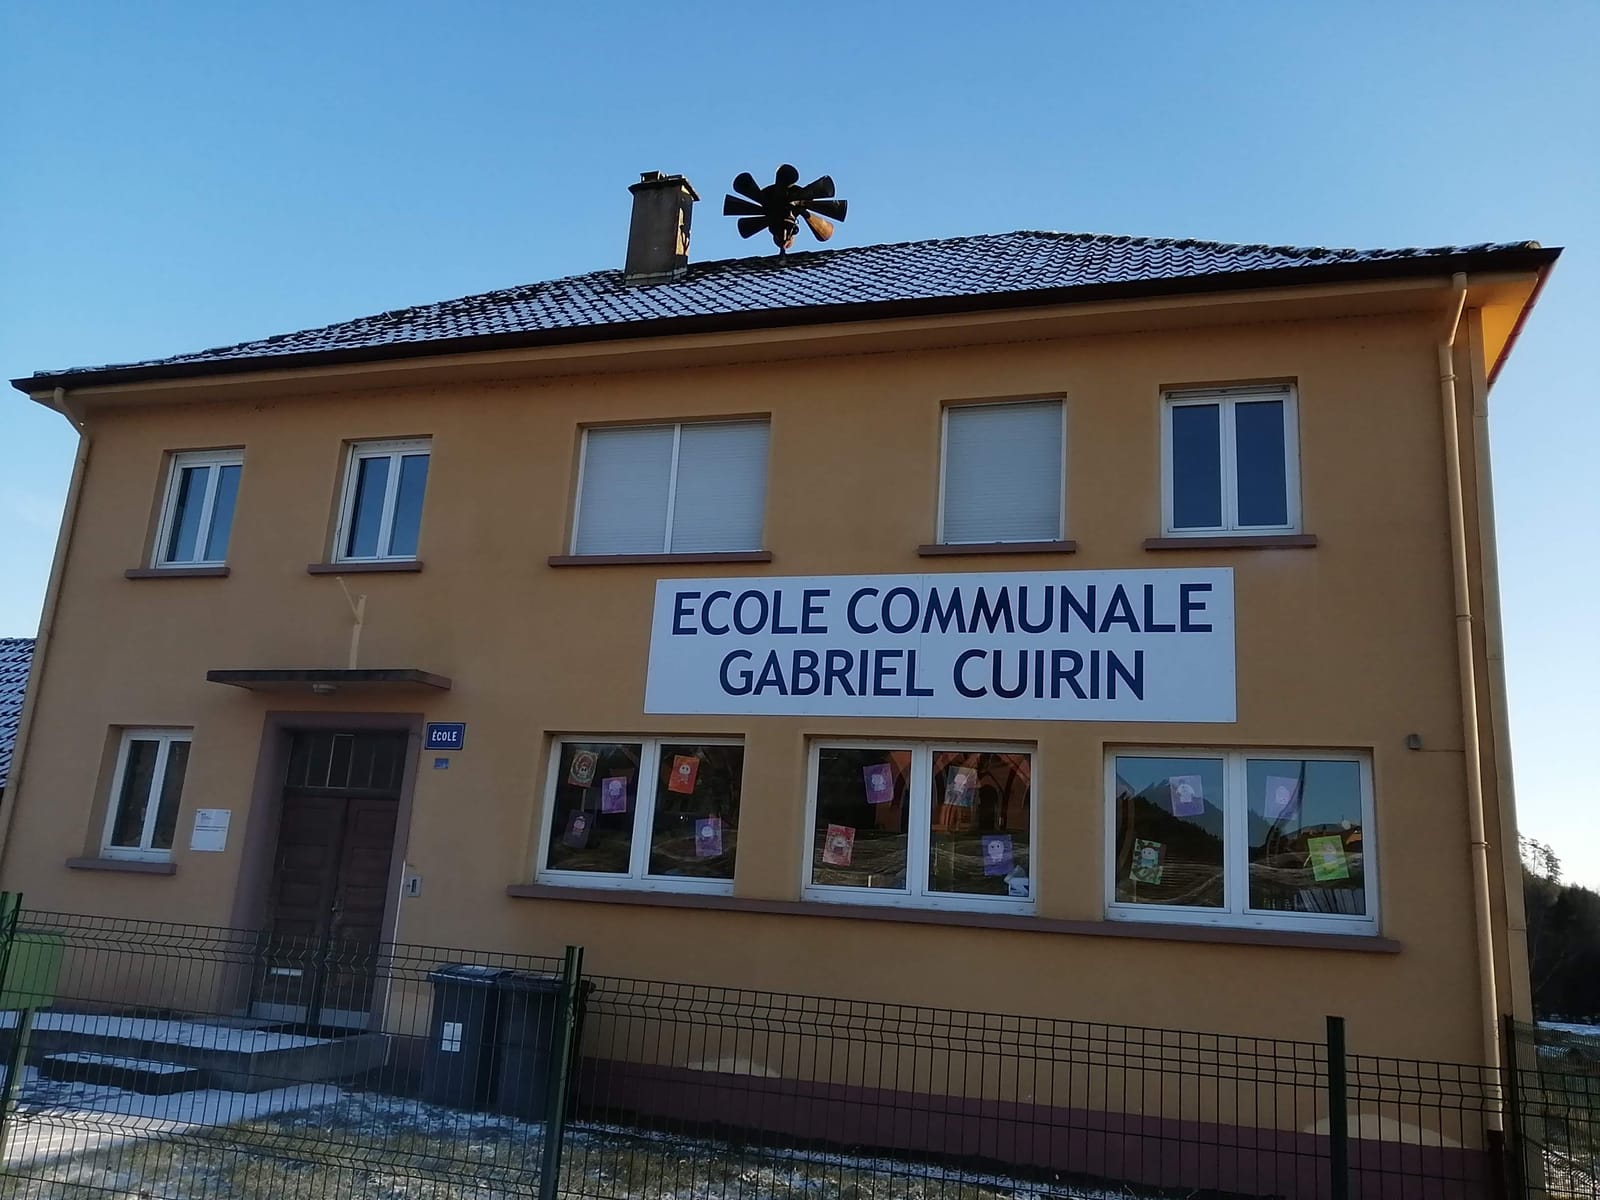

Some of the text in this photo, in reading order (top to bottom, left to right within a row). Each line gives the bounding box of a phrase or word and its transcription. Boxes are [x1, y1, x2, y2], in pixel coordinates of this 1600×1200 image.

[672, 583, 1213, 636] ECOLE COMMUNALE
[719, 648, 1144, 701] GABRIEL CUIRIN
[431, 729, 458, 742] ÉCOLE
